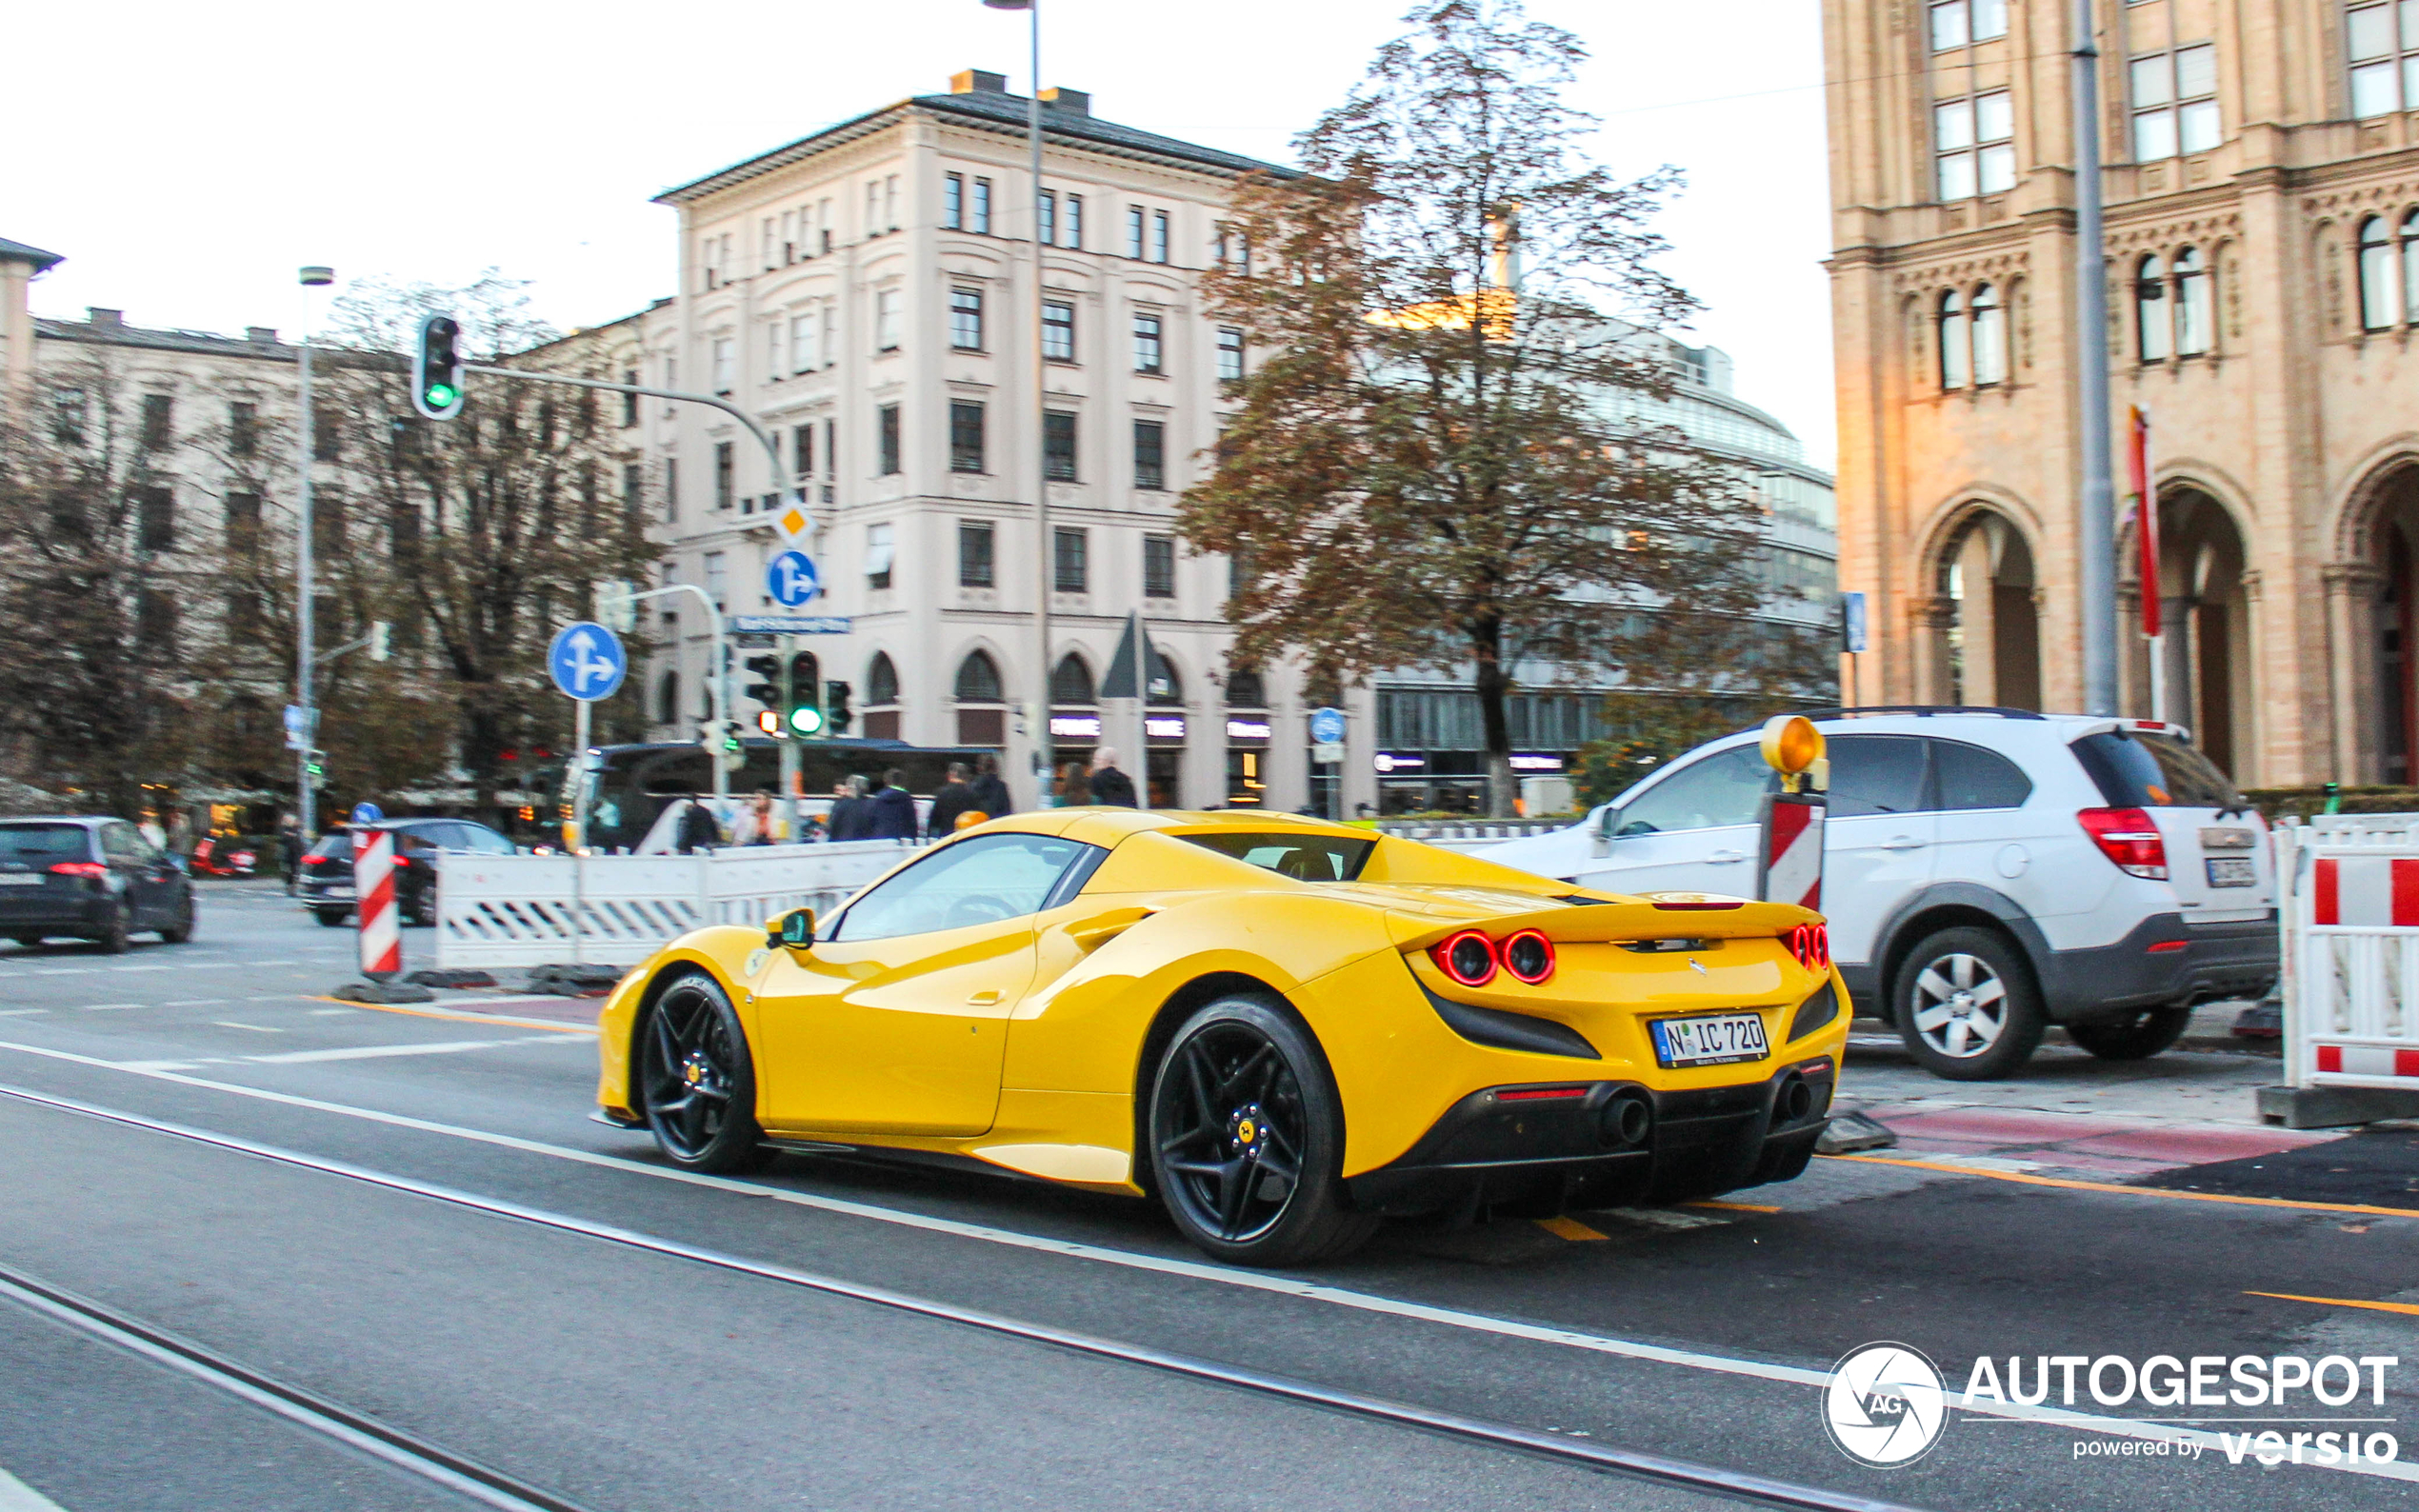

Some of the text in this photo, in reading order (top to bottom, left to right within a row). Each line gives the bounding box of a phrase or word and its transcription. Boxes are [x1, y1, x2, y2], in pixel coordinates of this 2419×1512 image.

[1667, 1020, 1763, 1056] N IC 720
